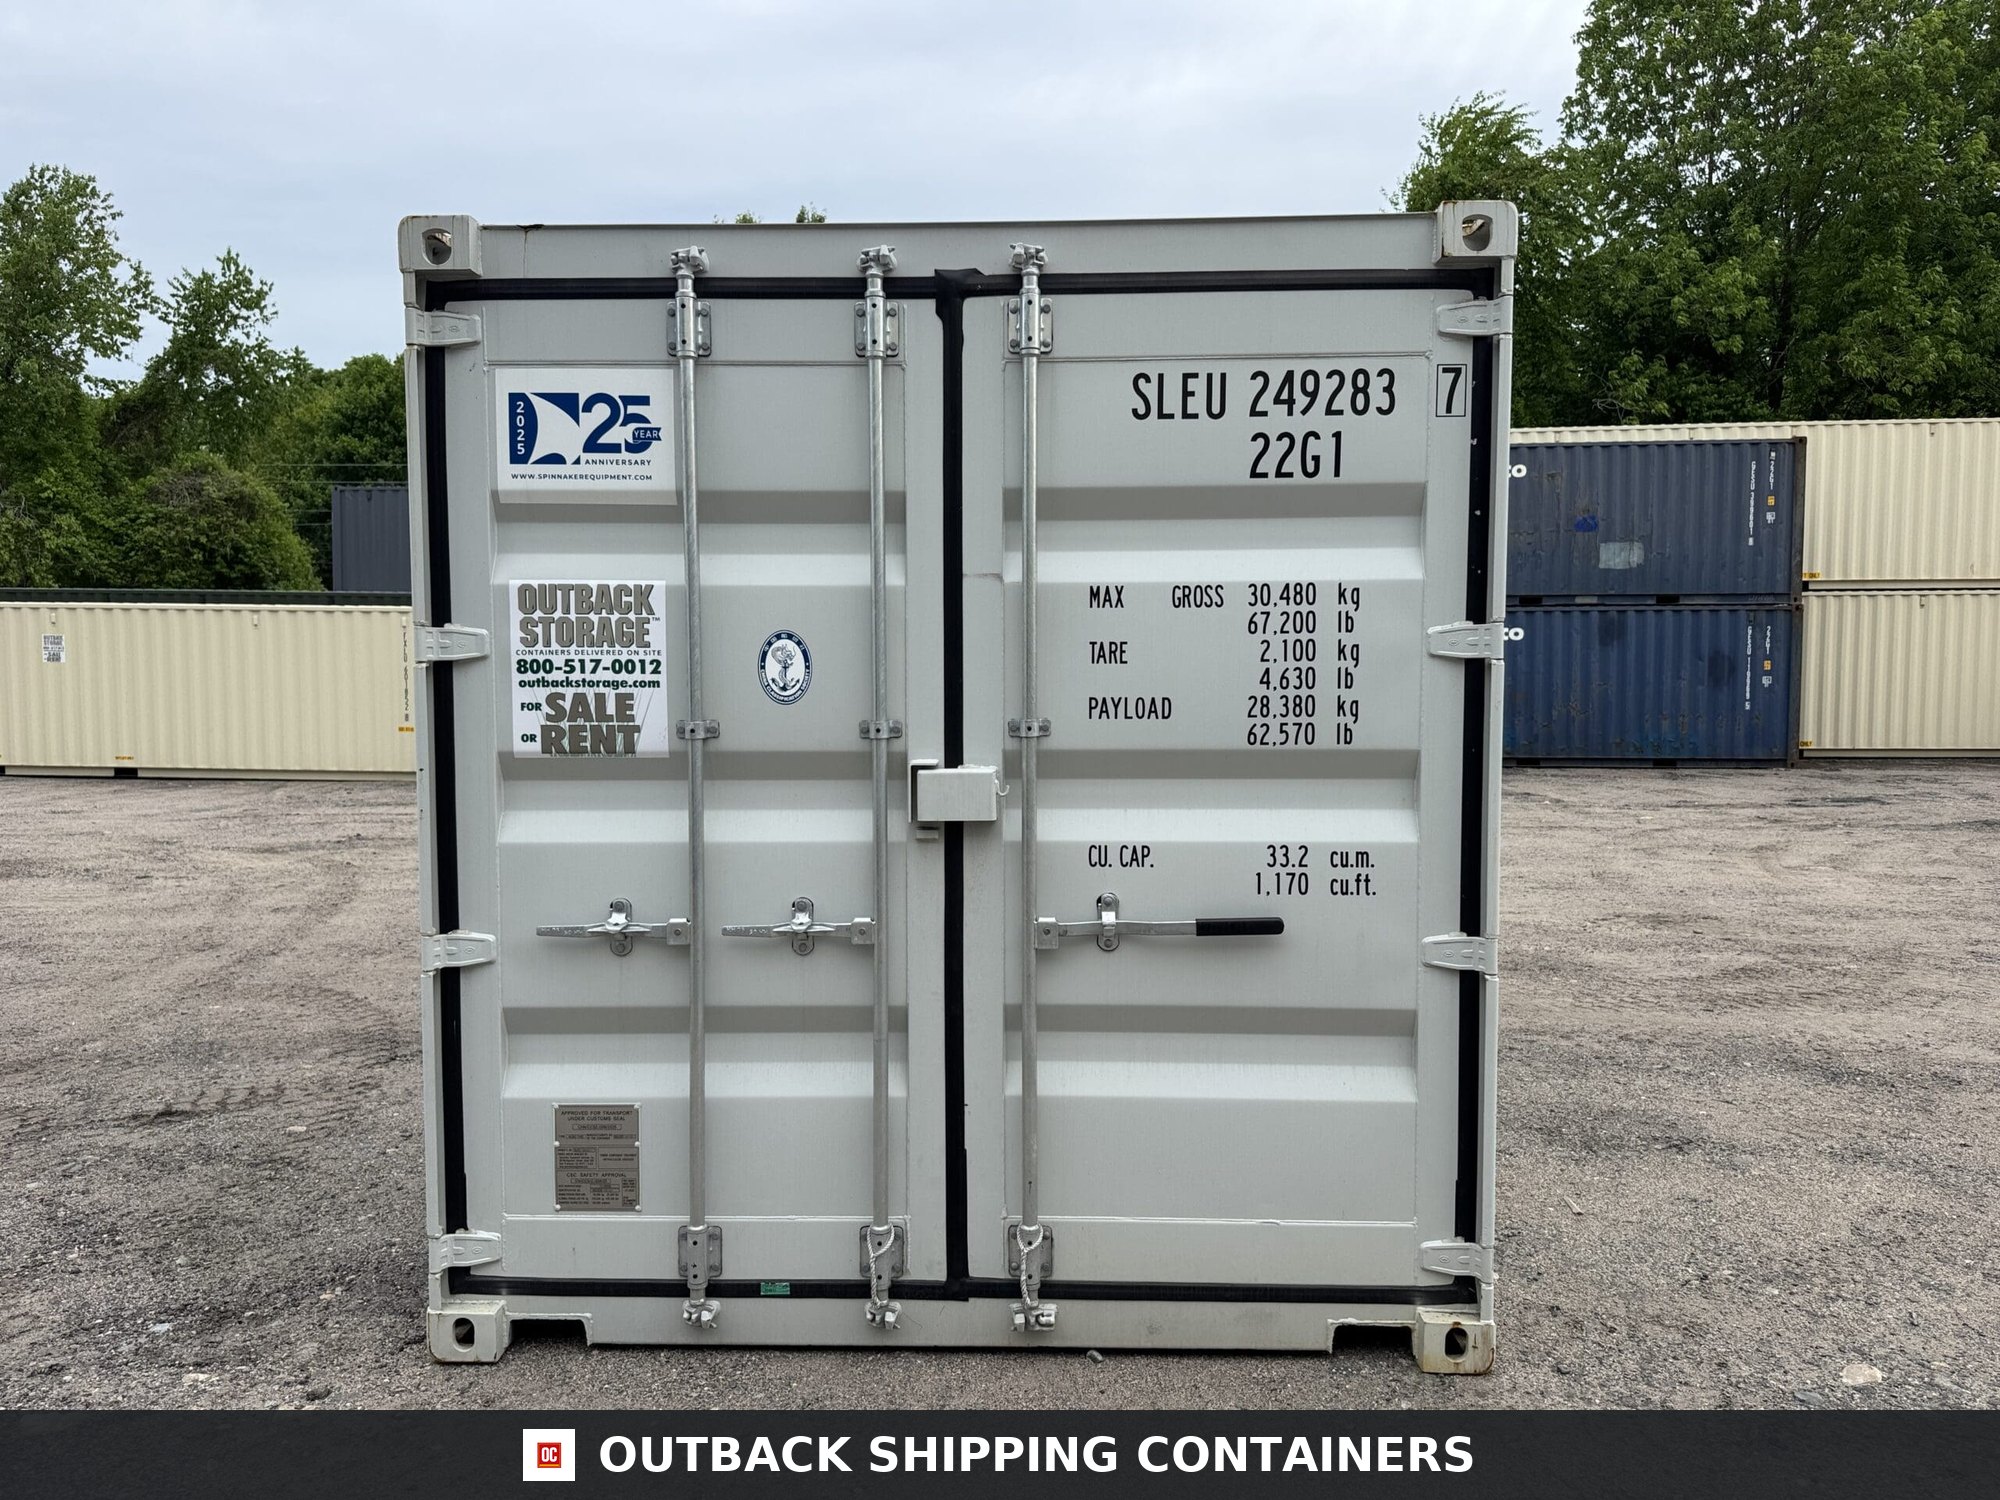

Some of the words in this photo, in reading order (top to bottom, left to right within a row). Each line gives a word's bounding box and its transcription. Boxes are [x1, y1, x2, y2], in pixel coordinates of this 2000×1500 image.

[1131, 372, 1227, 420] SLEU
[1248, 368, 1396, 417] 249283
[1441, 366, 1463, 414] 7
[516, 401, 525, 455] 2025
[581, 392, 653, 454] 25
[633, 429, 659, 439] YEAR
[1249, 430, 1342, 479] 22G1
[511, 473, 652, 481] WWW.SPINNAKEREQUIPMENT.COM
[517, 583, 656, 615] OUTBACK
[1089, 585, 1124, 608] MAX
[1171, 585, 1224, 608] GROSS
[1247, 582, 1317, 608] 30,480
[1337, 582, 1360, 612] kg
[519, 616, 651, 648] STORAGE
[1247, 610, 1317, 636] 67,200
[1337, 610, 1354, 633] lb
[516, 659, 662, 675] 800-517-0012
[1089, 641, 1128, 664] TARE
[1260, 639, 1317, 664] 2,100
[1337, 639, 1360, 668] kg
[518, 676, 661, 690] outbackstorage.com
[1259, 667, 1316, 691] 4,630
[1337, 667, 1354, 689] lb
[520, 702, 542, 711] FOR
[545, 692, 635, 723] SALE
[1088, 697, 1172, 720] PAYLOAD
[1247, 694, 1316, 720] 28,380
[1336, 694, 1359, 724] kg
[521, 734, 537, 743] OR
[540, 724, 641, 754] RENT
[1247, 723, 1316, 747] 62,570
[1336, 722, 1353, 745] lb
[1088, 845, 1112, 868] CU.
[1119, 845, 1154, 868] CAP.
[1266, 845, 1309, 868] 33.2
[1329, 850, 1375, 868] cu.m.
[1255, 872, 1309, 897] 1,170
[1329, 873, 1377, 896] cu.ft.
